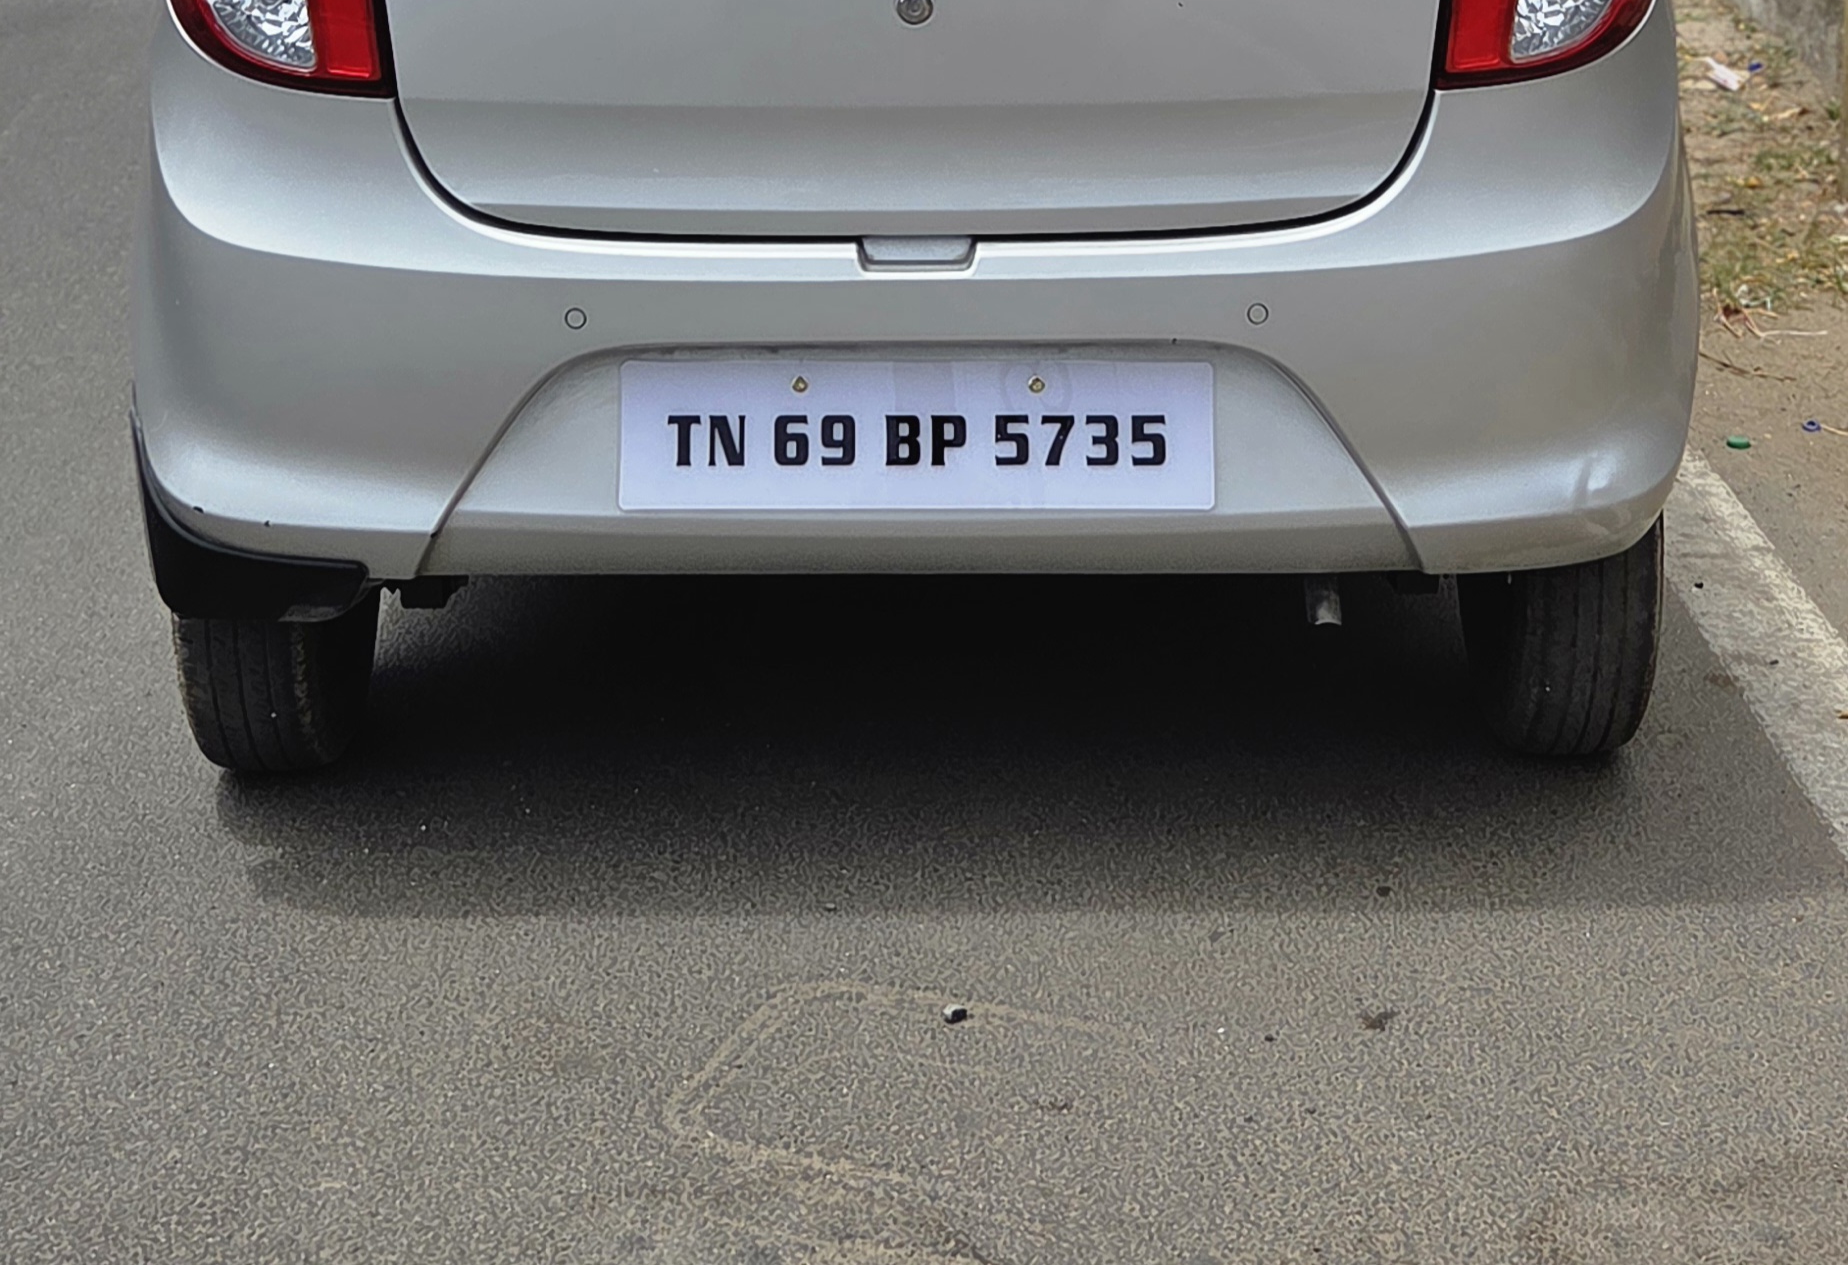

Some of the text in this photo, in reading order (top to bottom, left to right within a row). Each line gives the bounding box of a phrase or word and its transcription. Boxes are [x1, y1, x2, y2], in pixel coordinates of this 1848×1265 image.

[667, 414, 1167, 467] TN 69 BP 5735
